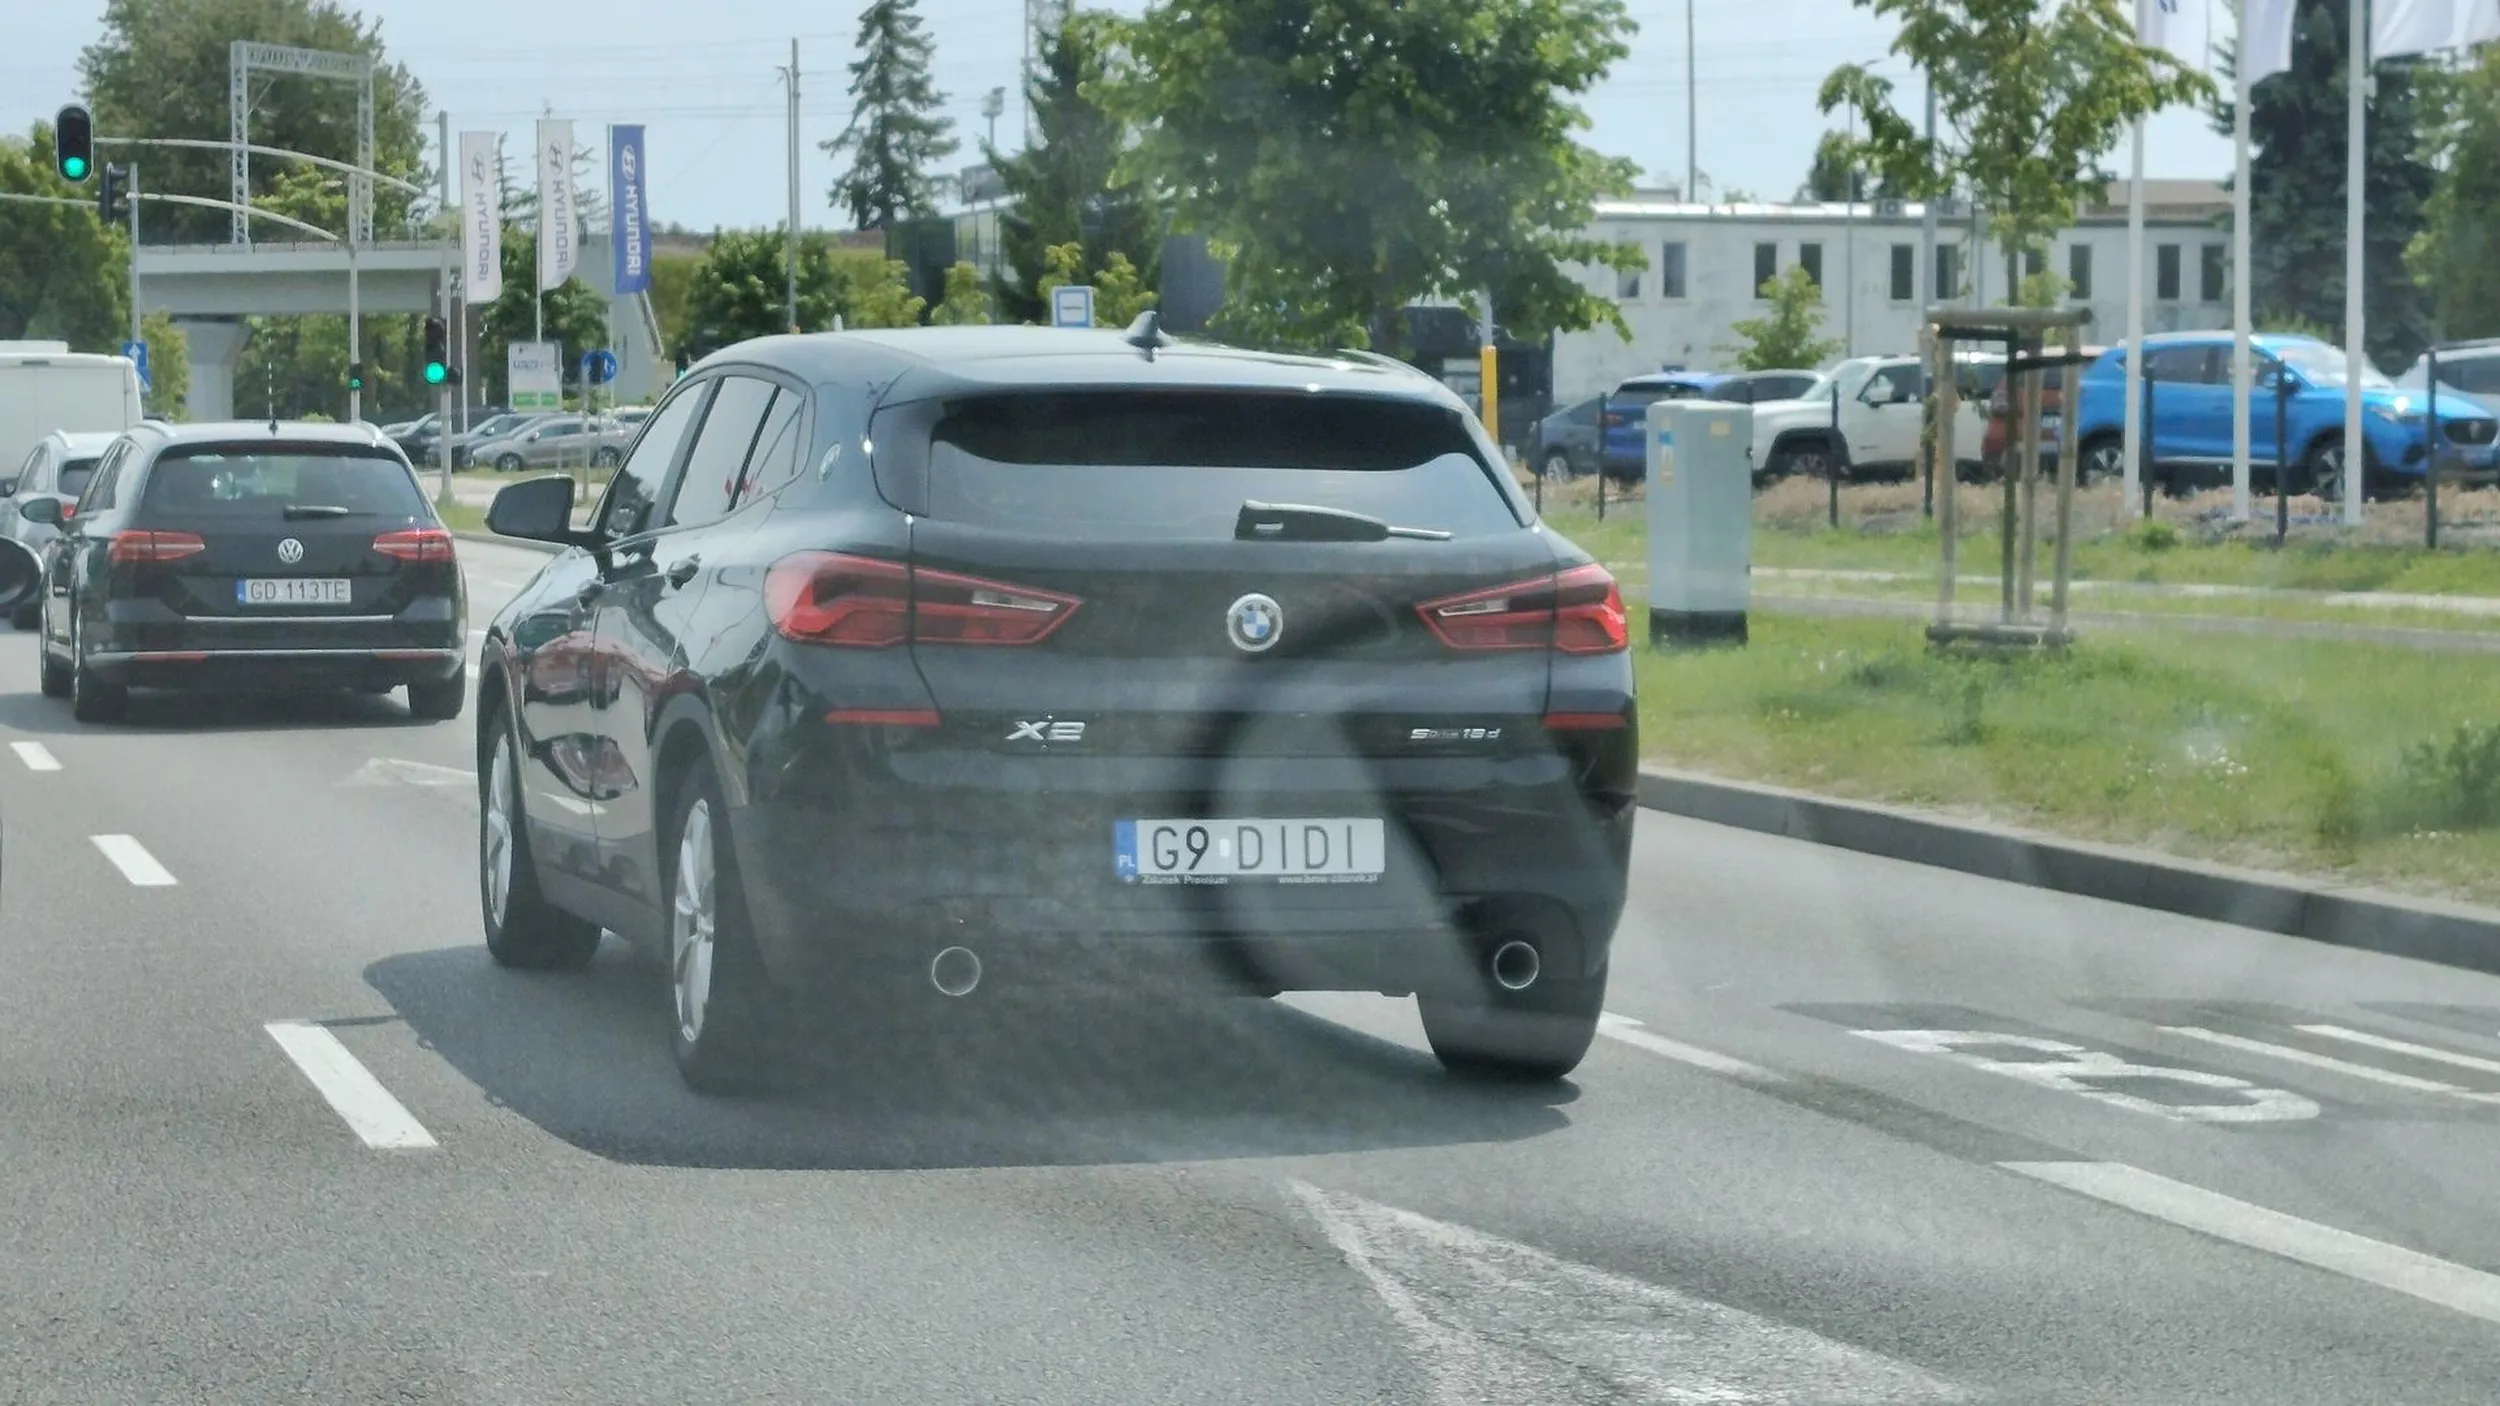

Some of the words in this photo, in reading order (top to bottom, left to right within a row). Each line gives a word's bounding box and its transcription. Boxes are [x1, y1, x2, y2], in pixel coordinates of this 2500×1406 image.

[475, 193, 490, 281] HYUNDAI
[552, 180, 569, 269] HYUNDAI
[625, 185, 641, 276] HYUNDAI
[250, 581, 276, 600] GD
[286, 581, 346, 600] 113TE
[1004, 721, 1085, 740] X2
[1119, 854, 1136, 867] PL
[1152, 825, 1210, 870] G9
[1237, 824, 1354, 870] DIDI
